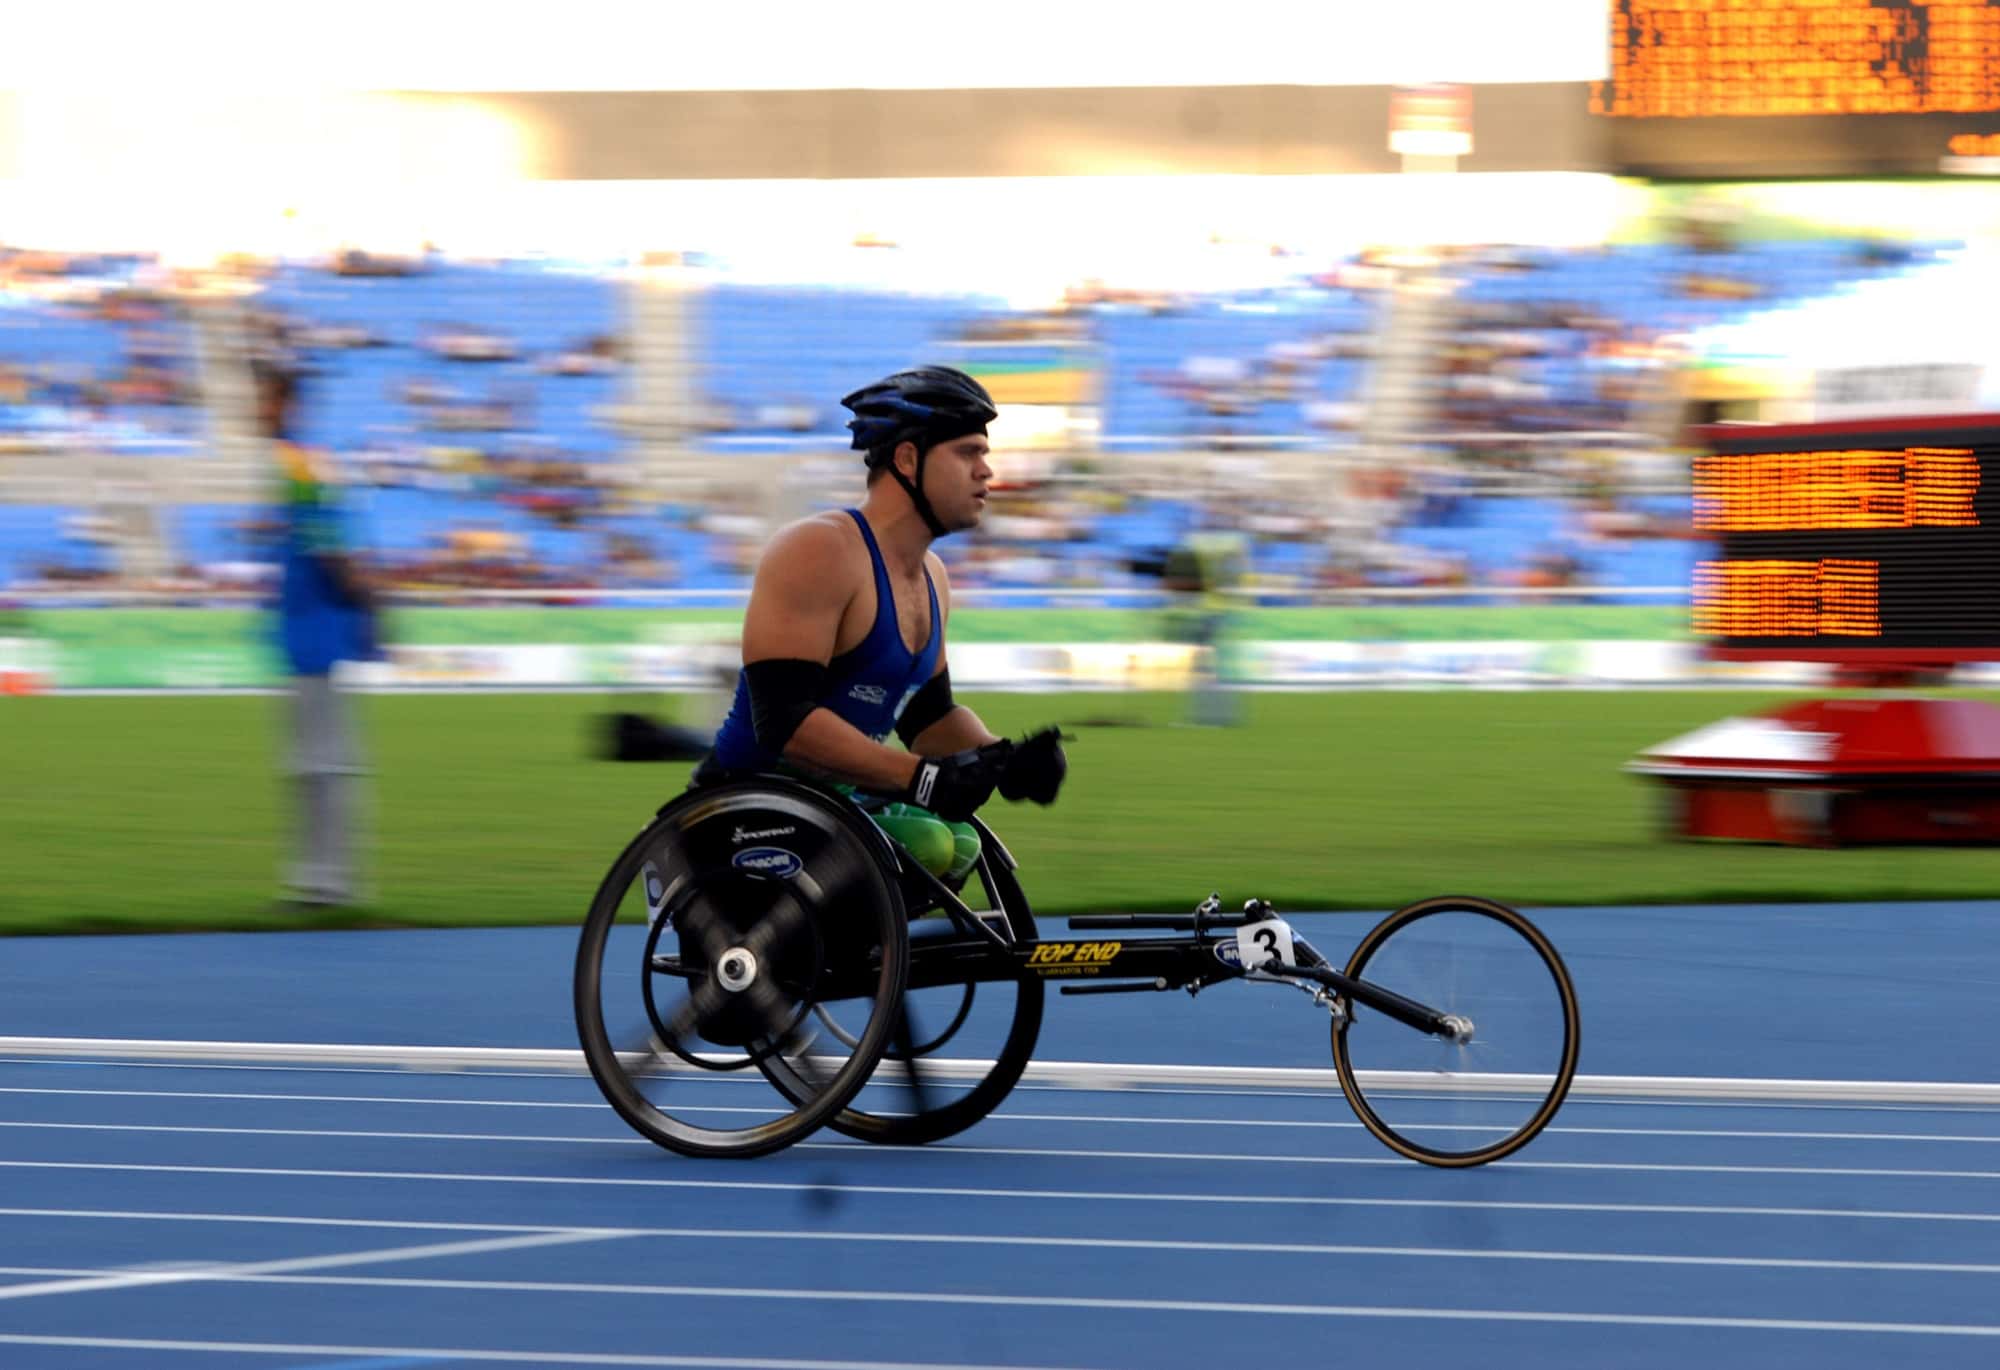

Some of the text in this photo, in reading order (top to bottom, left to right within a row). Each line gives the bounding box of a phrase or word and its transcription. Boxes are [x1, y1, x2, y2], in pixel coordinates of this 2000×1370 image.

[1029, 941, 1122, 962] TOP END
[1253, 928, 1282, 963] 3
